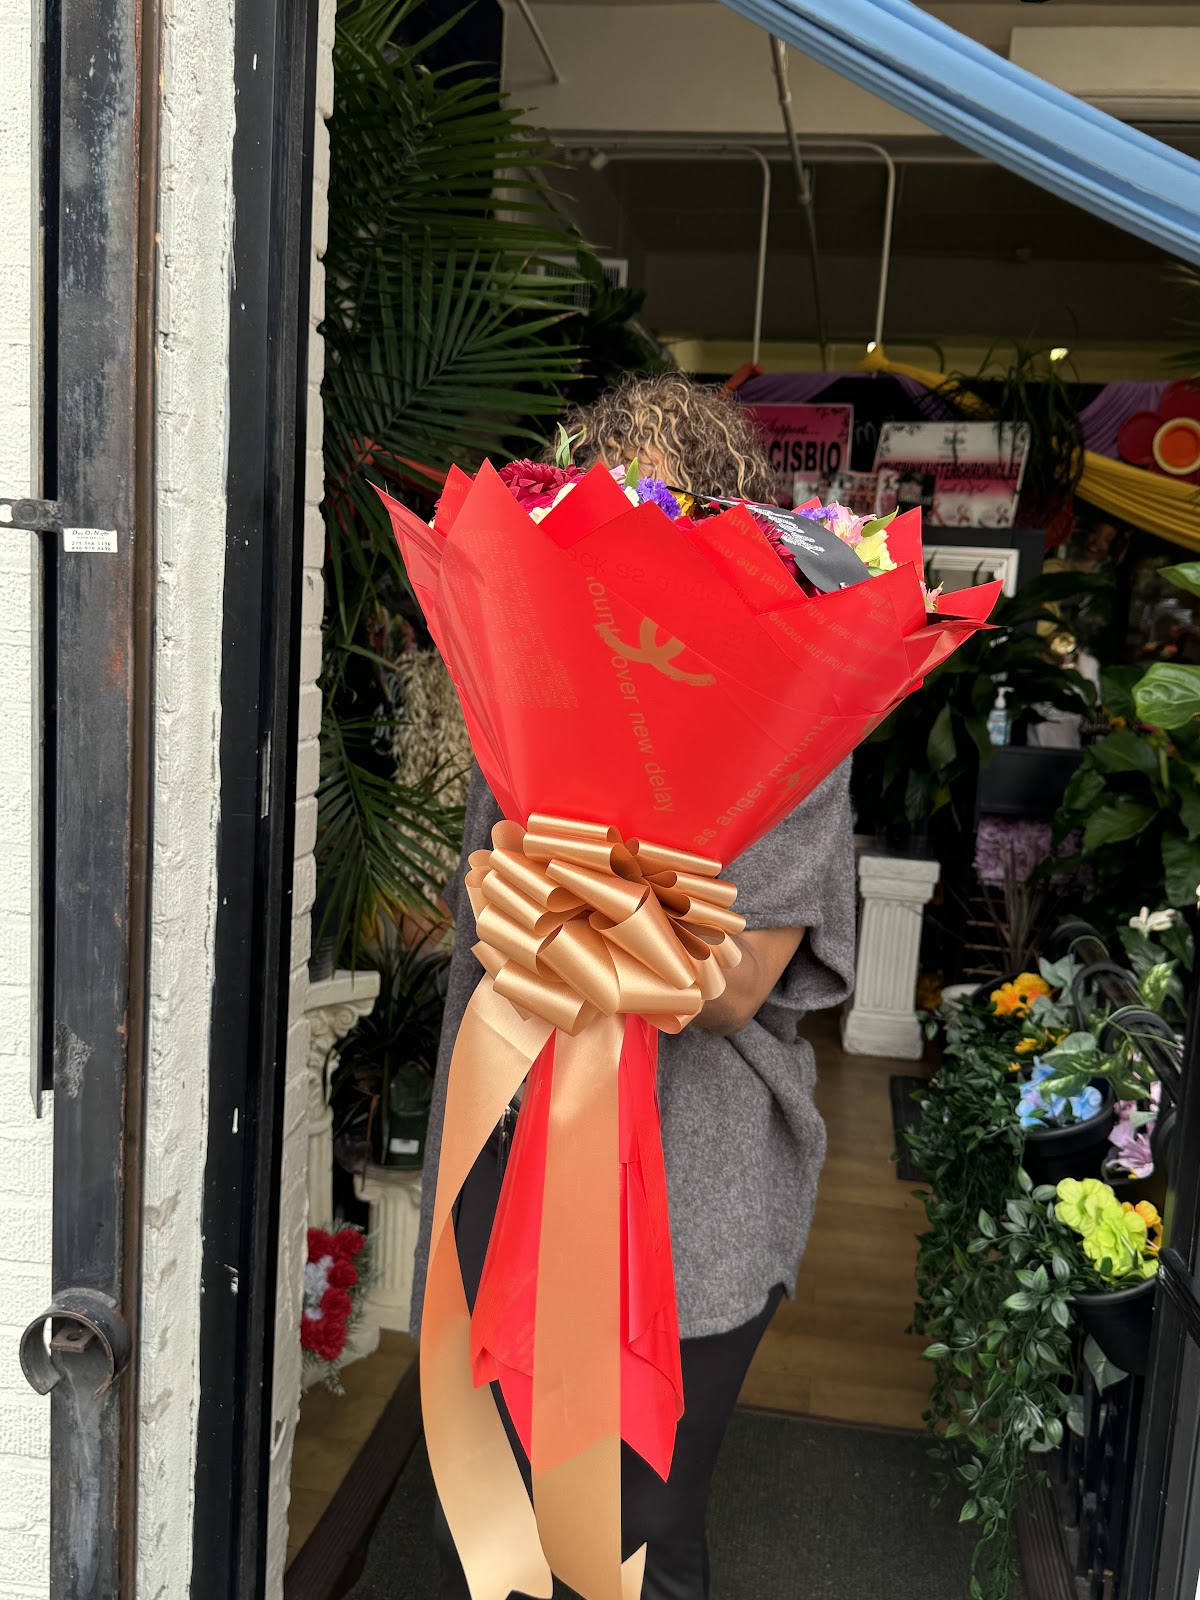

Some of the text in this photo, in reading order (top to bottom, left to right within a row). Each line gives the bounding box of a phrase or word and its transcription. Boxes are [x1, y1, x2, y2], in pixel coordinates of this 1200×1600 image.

[769, 441, 841, 472] CISBIO
[611, 655, 640, 704] over
[629, 711, 655, 754] new
[644, 760, 677, 814] delay
[692, 828, 718, 847] as
[716, 780, 767, 827] anger
